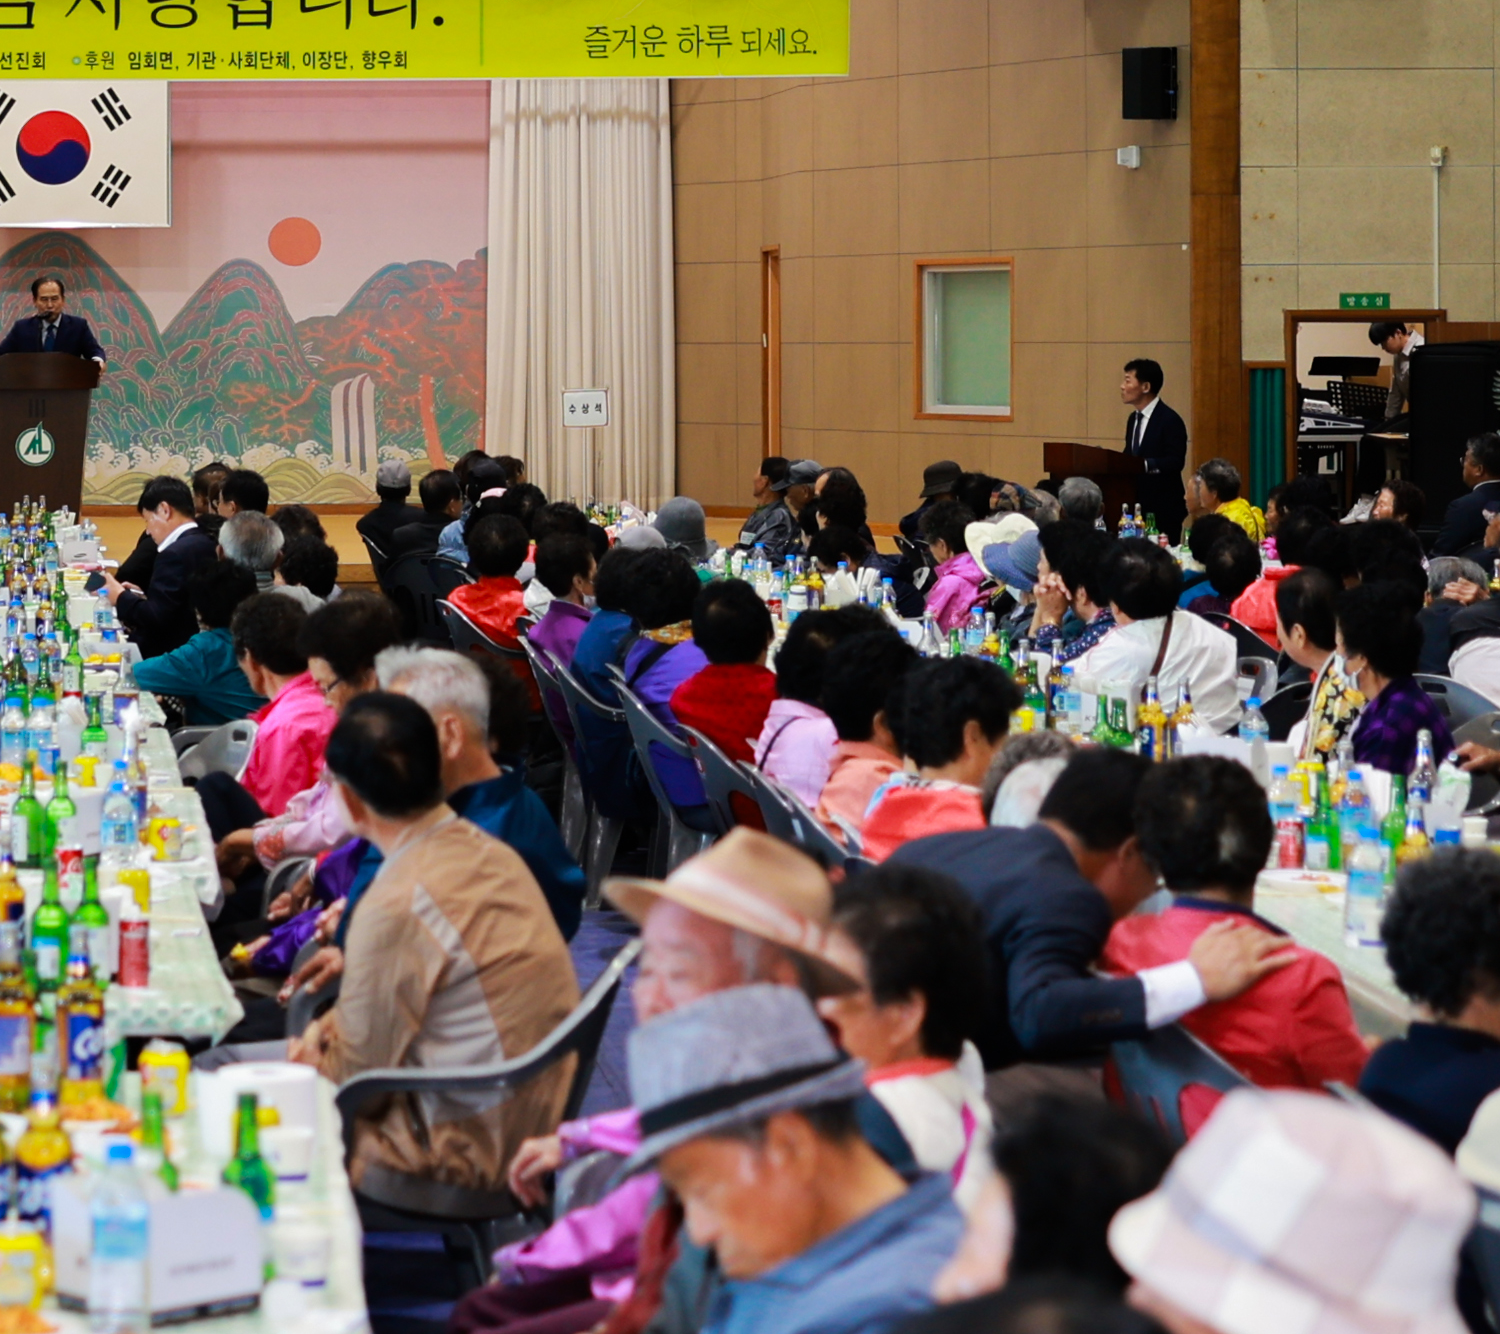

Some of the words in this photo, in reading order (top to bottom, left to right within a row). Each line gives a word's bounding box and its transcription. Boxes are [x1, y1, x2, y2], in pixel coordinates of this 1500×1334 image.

[583, 24, 668, 59] 즐거운
[676, 24, 733, 59] 하루
[740, 27, 818, 57] 되세요.
[84, 50, 115, 71] 후원
[128, 50, 179, 71] 임회면,
[302, 50, 354, 71] 이장단,
[361, 50, 407, 70] 향우회
